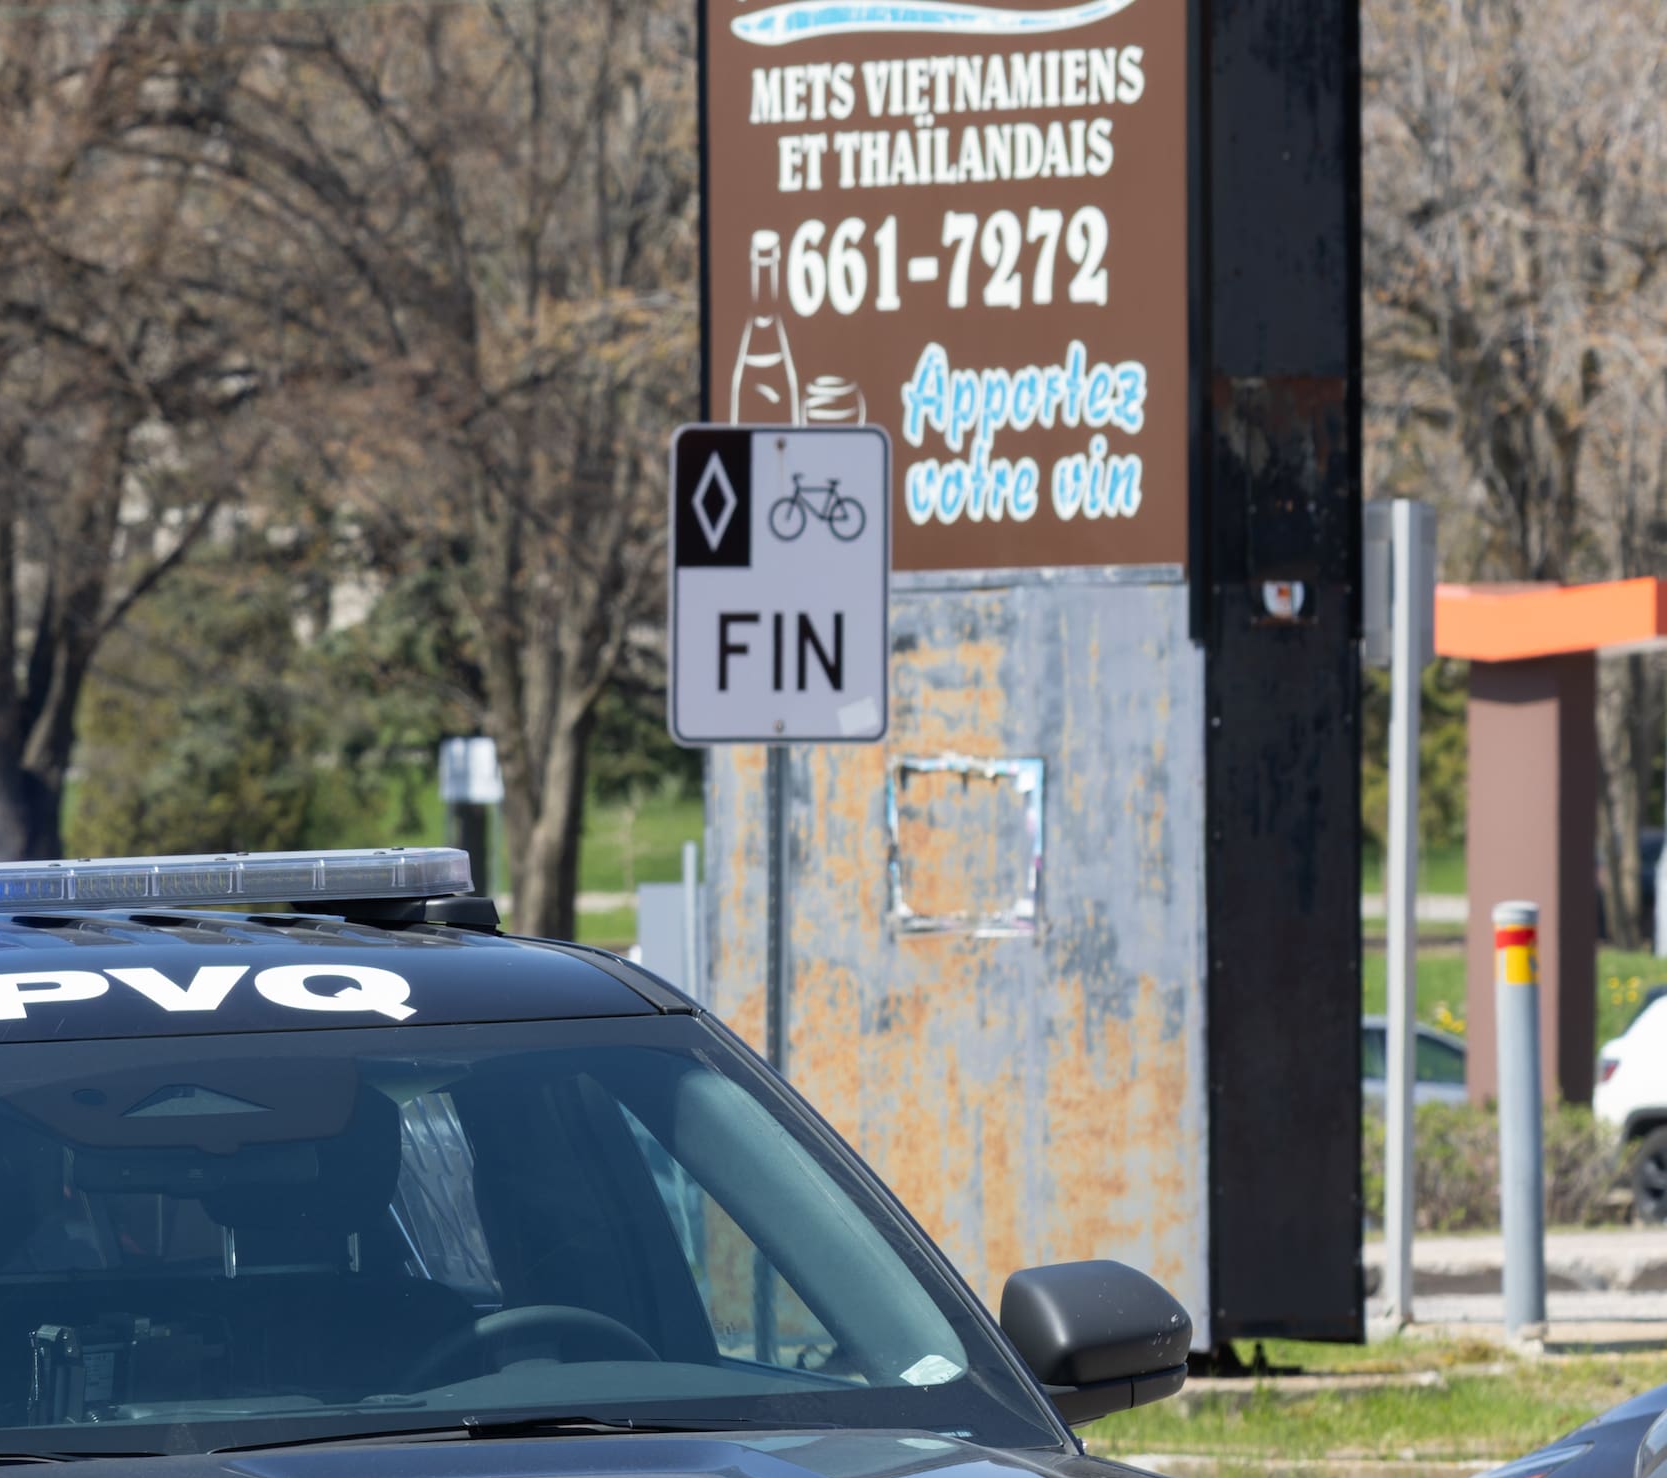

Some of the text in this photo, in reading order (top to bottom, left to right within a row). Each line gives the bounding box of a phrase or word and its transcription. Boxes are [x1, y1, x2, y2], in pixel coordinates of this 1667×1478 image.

[750, 45, 1146, 124] METS VIETNAMIENS
[777, 114, 1115, 192] ET THAÏLANDAIS
[787, 206, 1109, 316] 661-7272
[902, 340, 1147, 452] Apportez
[905, 435, 1143, 525] votre vin
[717, 612, 844, 693] FIN
